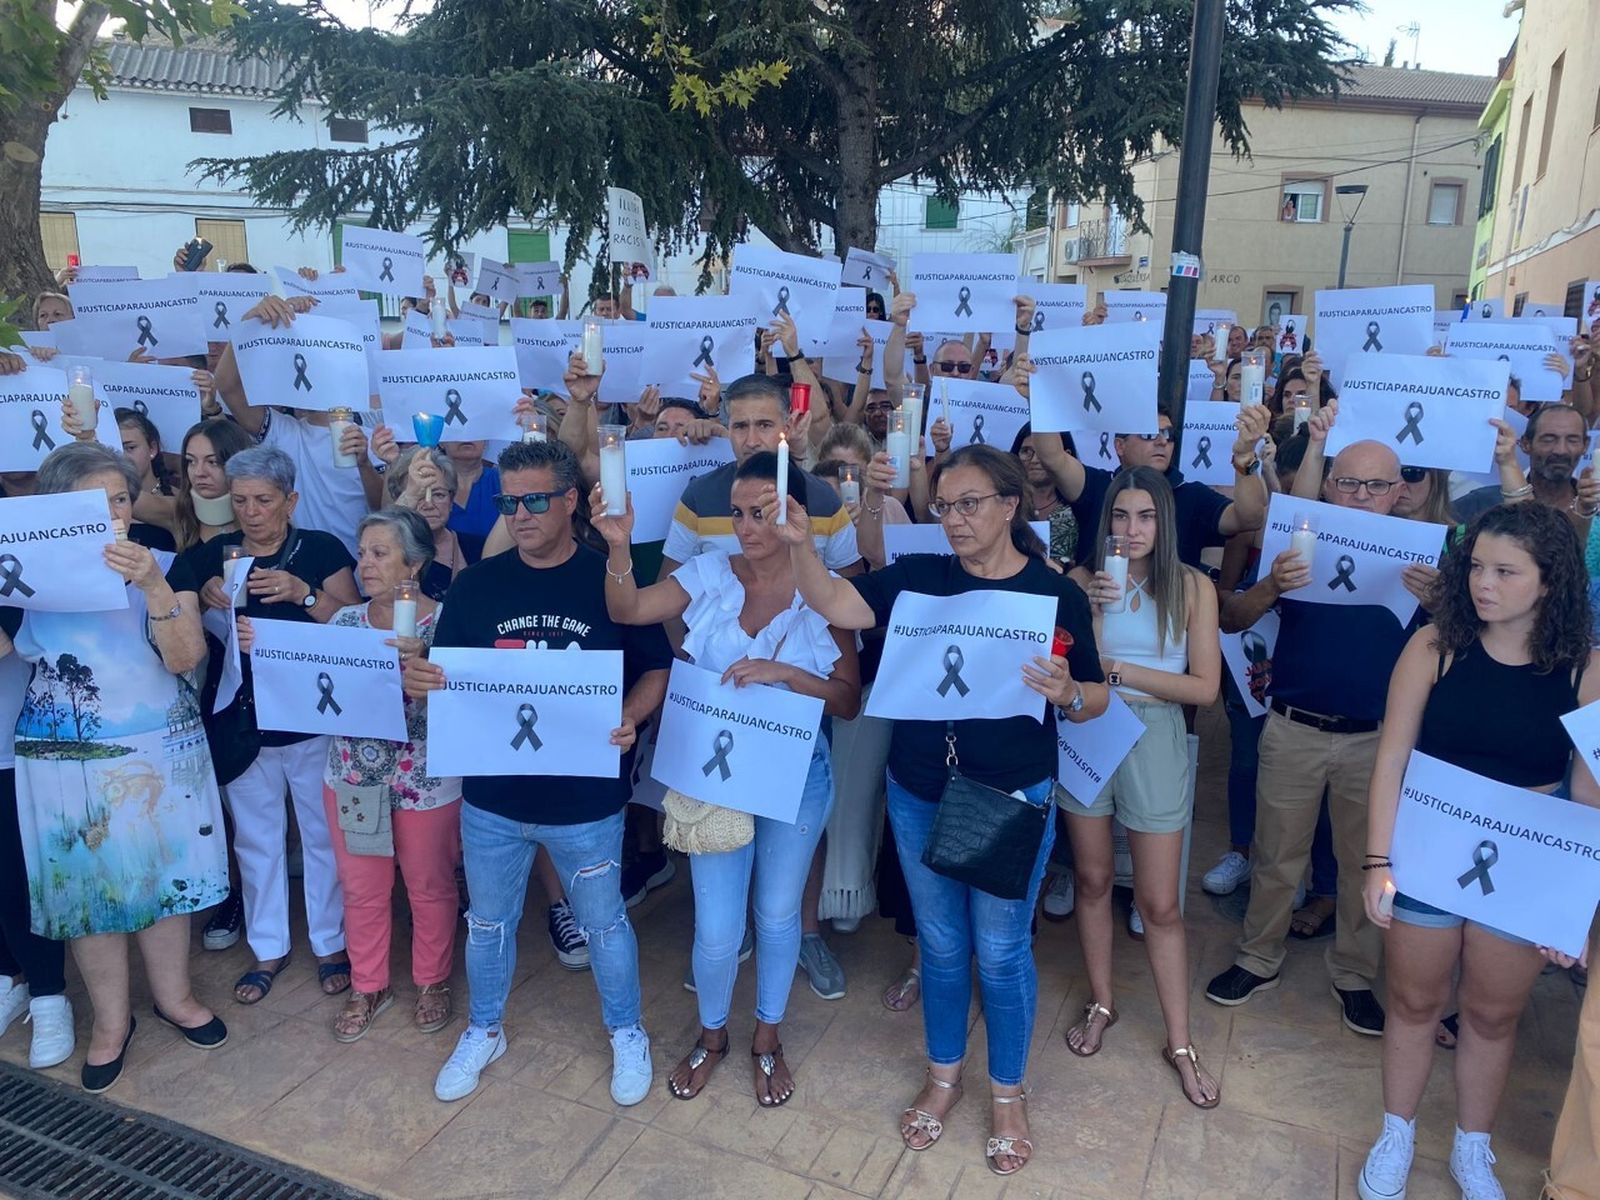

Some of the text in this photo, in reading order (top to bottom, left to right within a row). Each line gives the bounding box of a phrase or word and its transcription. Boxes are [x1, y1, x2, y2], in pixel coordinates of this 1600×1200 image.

[617, 216, 631, 227] NO
[613, 233, 642, 247] RACIS
[345, 241, 423, 260] #JUSTICIAPARAJUANCASTRO
[735, 265, 837, 291] #JUSTICIAPARAJUANCASTRO
[914, 273, 1016, 281] #JUSTICIAPARAJUANCASTRO
[1210, 274, 1241, 284] ARCO
[77, 297, 198, 313] #JUSTICIAPARAJUANCASTRO
[1318, 305, 1432, 318] #JUSTICIAPARAJUANCASTRO
[650, 317, 757, 330] #JUSTICIAPARAJUANCASTRO
[238, 336, 363, 352] #JUSTICIAPARAJUANCASTRO
[382, 371, 516, 384] #JUSTICIAPARAJUANCASTRO
[1343, 380, 1501, 400] #JUSTICIAPARAJUANCASTRO
[496, 614, 592, 637] CHANGE THE GAME
[894, 624, 1048, 644] #JUSTICIAPARAJUANCASTRO
[255, 647, 395, 670] #JUSTICIAPARAJUANCASTRO
[443, 681, 617, 696] JUSTICIAPARAJUANCASTRO
[669, 691, 813, 741] #JUSTICIAPARAJUANCASTRO
